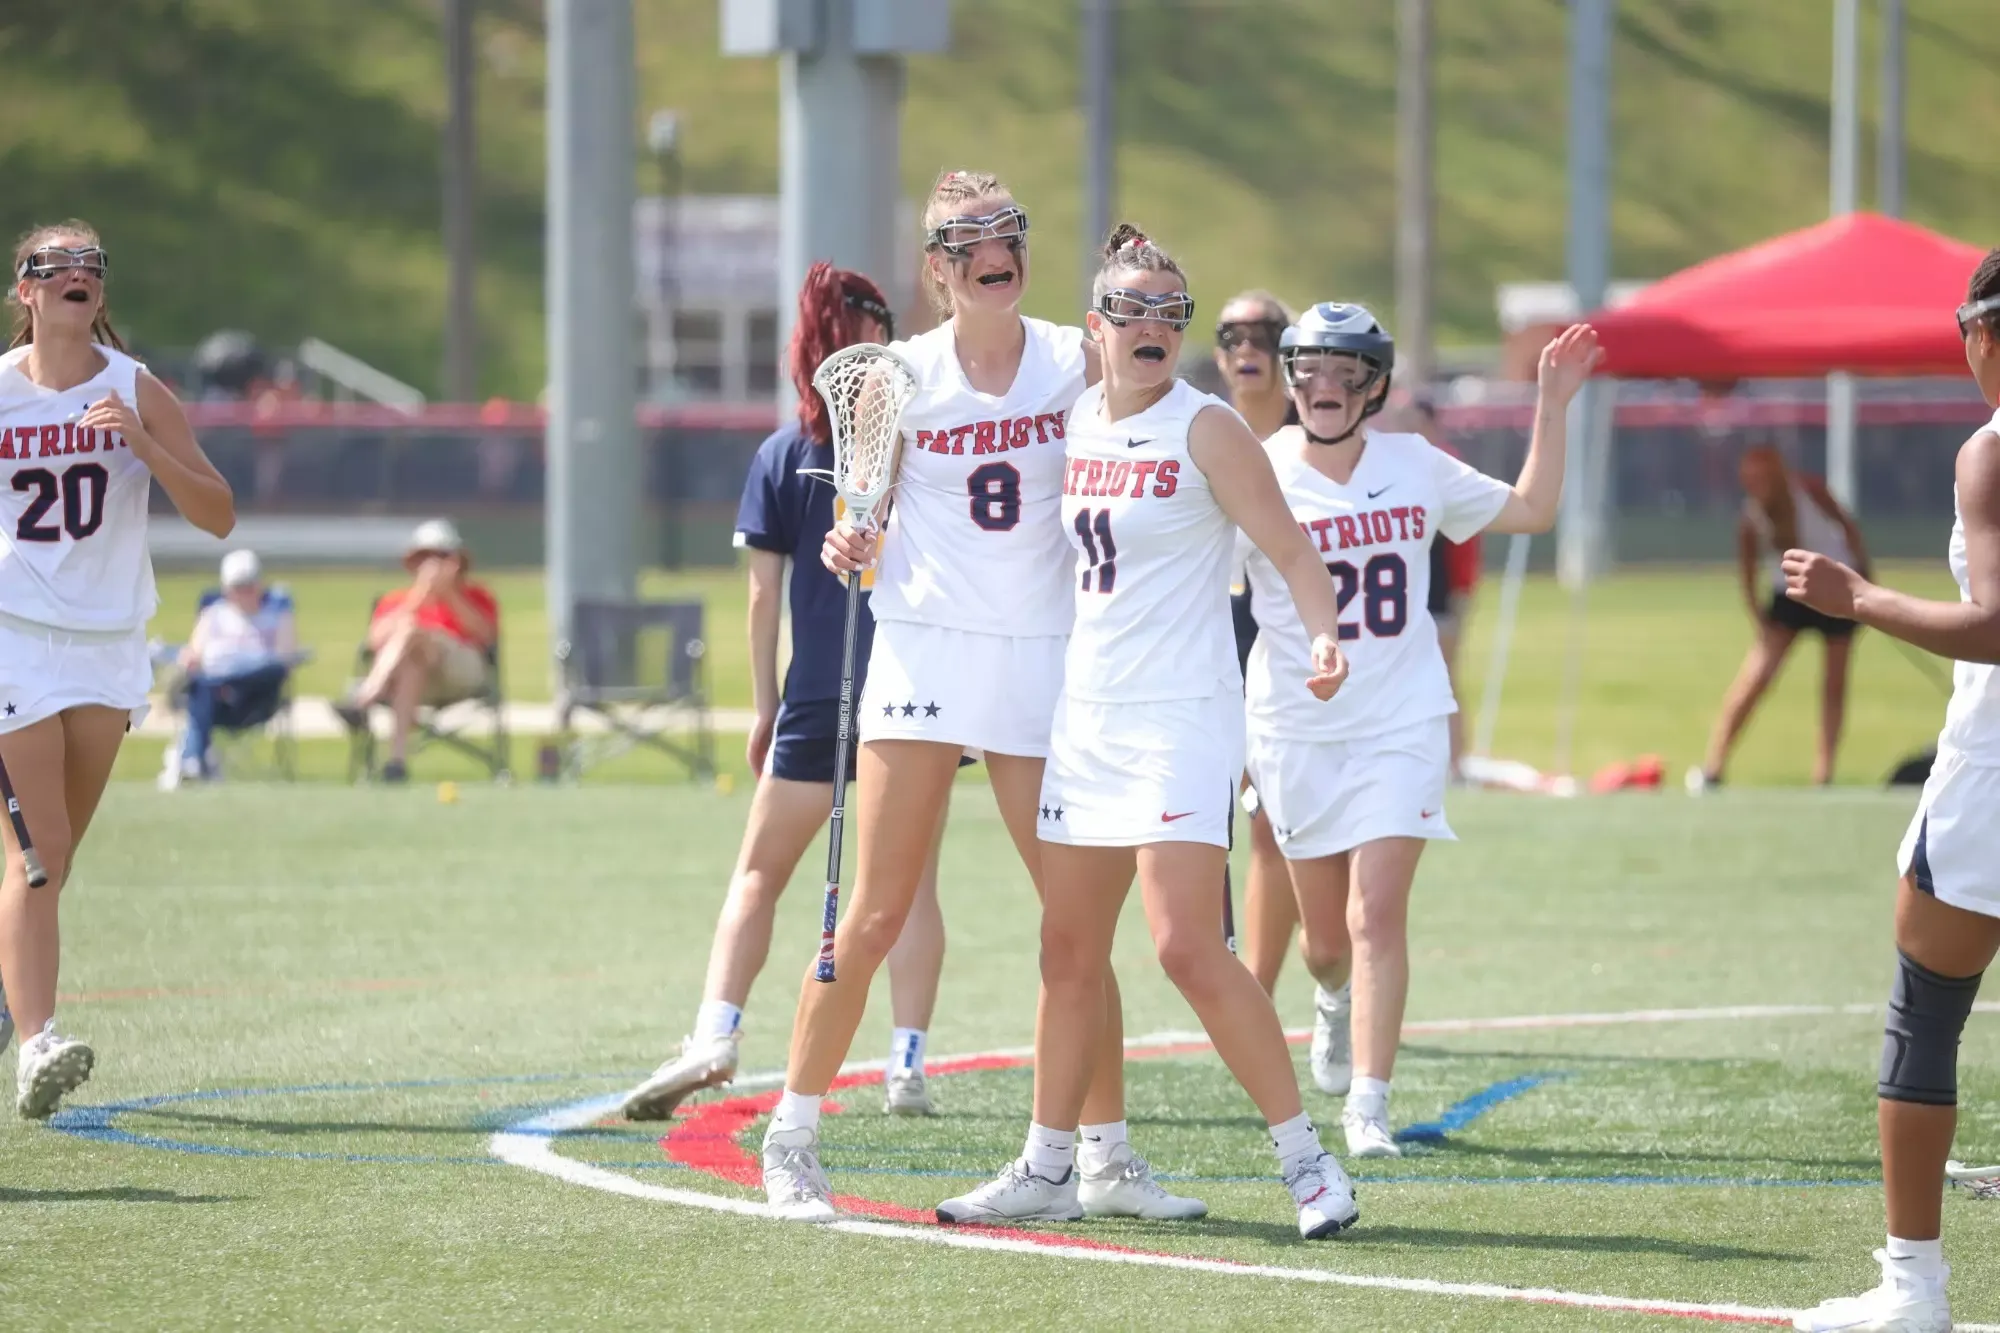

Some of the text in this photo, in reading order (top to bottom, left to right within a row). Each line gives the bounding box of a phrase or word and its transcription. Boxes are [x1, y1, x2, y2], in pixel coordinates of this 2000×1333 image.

[917, 410, 1066, 455] PATRIOTS
[10, 462, 109, 541] 20
[967, 461, 1021, 531] 8
[1074, 507, 1116, 594] 11
[1326, 552, 1407, 641] 28
[839, 679, 852, 740] CUMBERLANDS
